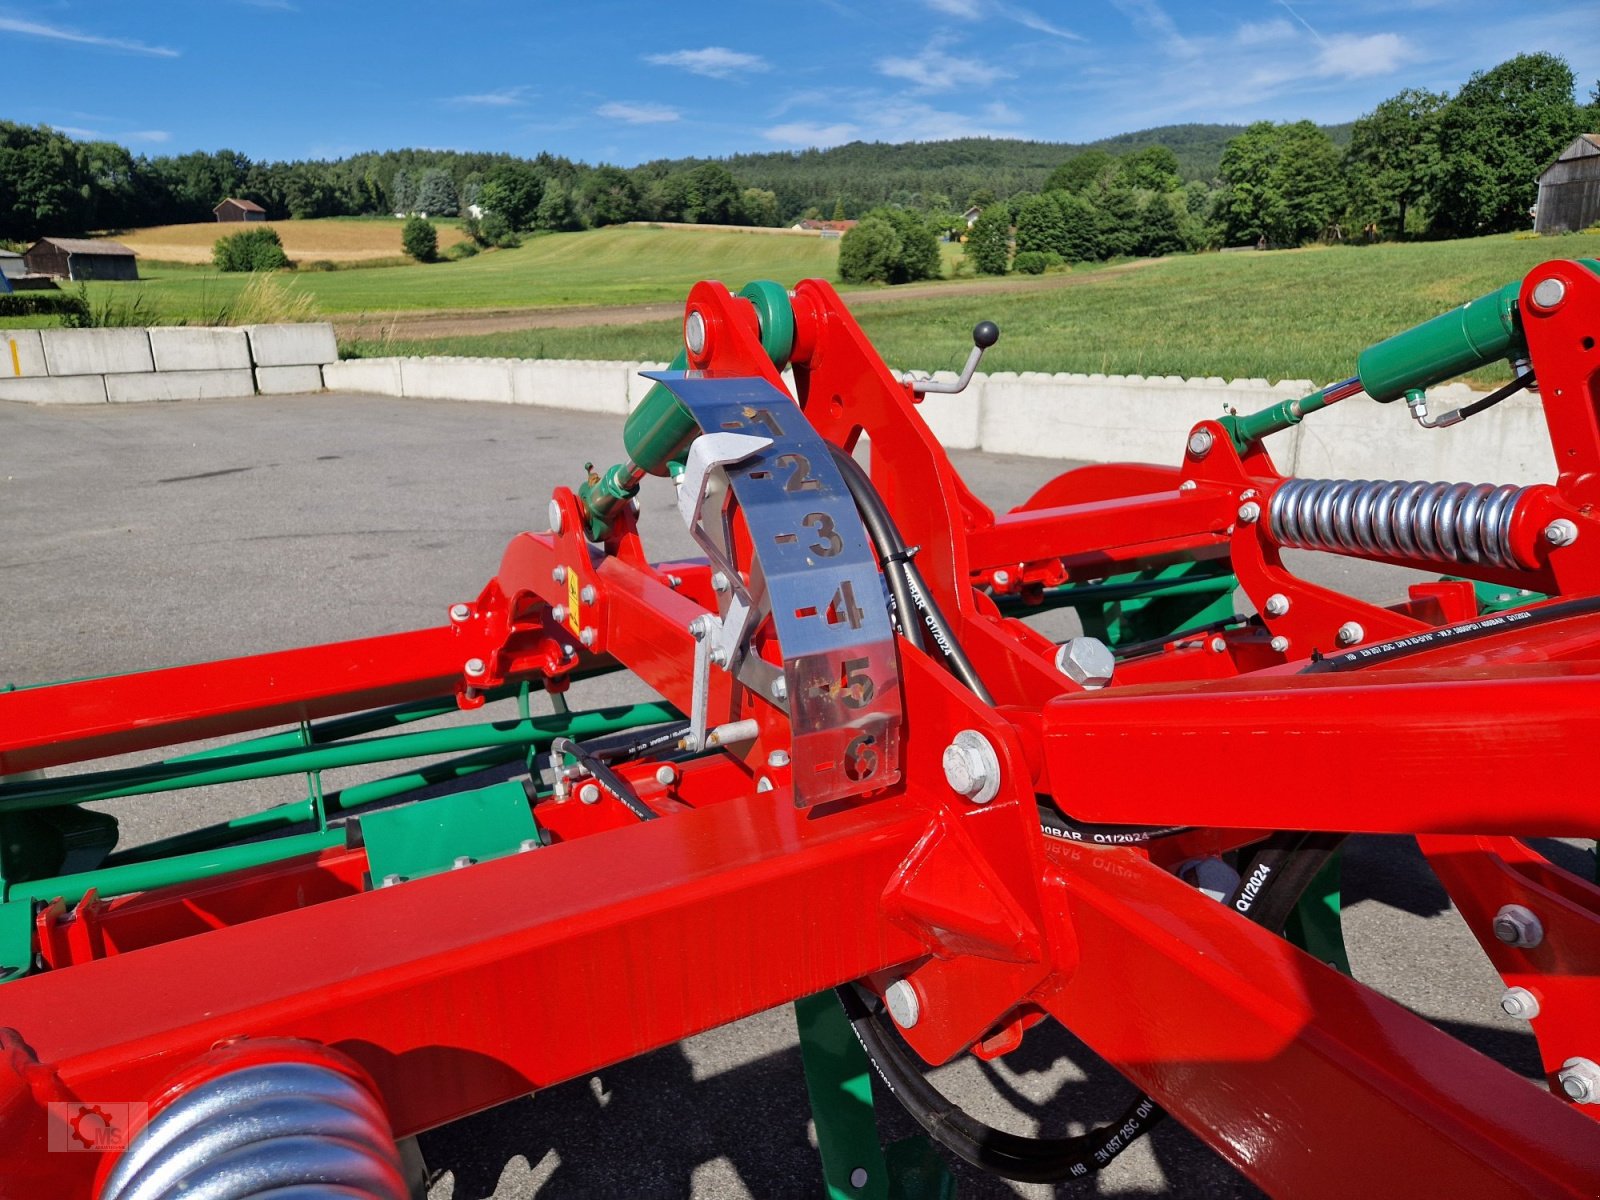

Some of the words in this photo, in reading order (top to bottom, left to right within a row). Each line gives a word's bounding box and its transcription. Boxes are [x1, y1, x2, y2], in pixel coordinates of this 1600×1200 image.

[925, 615, 952, 656] Q1/2024
[1093, 831, 1150, 843] Q1/2024
[1236, 863, 1271, 911] Q1/2024
[1070, 1162, 1087, 1176] HB
[1094, 1149, 1110, 1162] EN
[1106, 1135, 1123, 1153] 857
[1120, 1118, 1139, 1140] 2SC
[1136, 1100, 1153, 1118] DN
